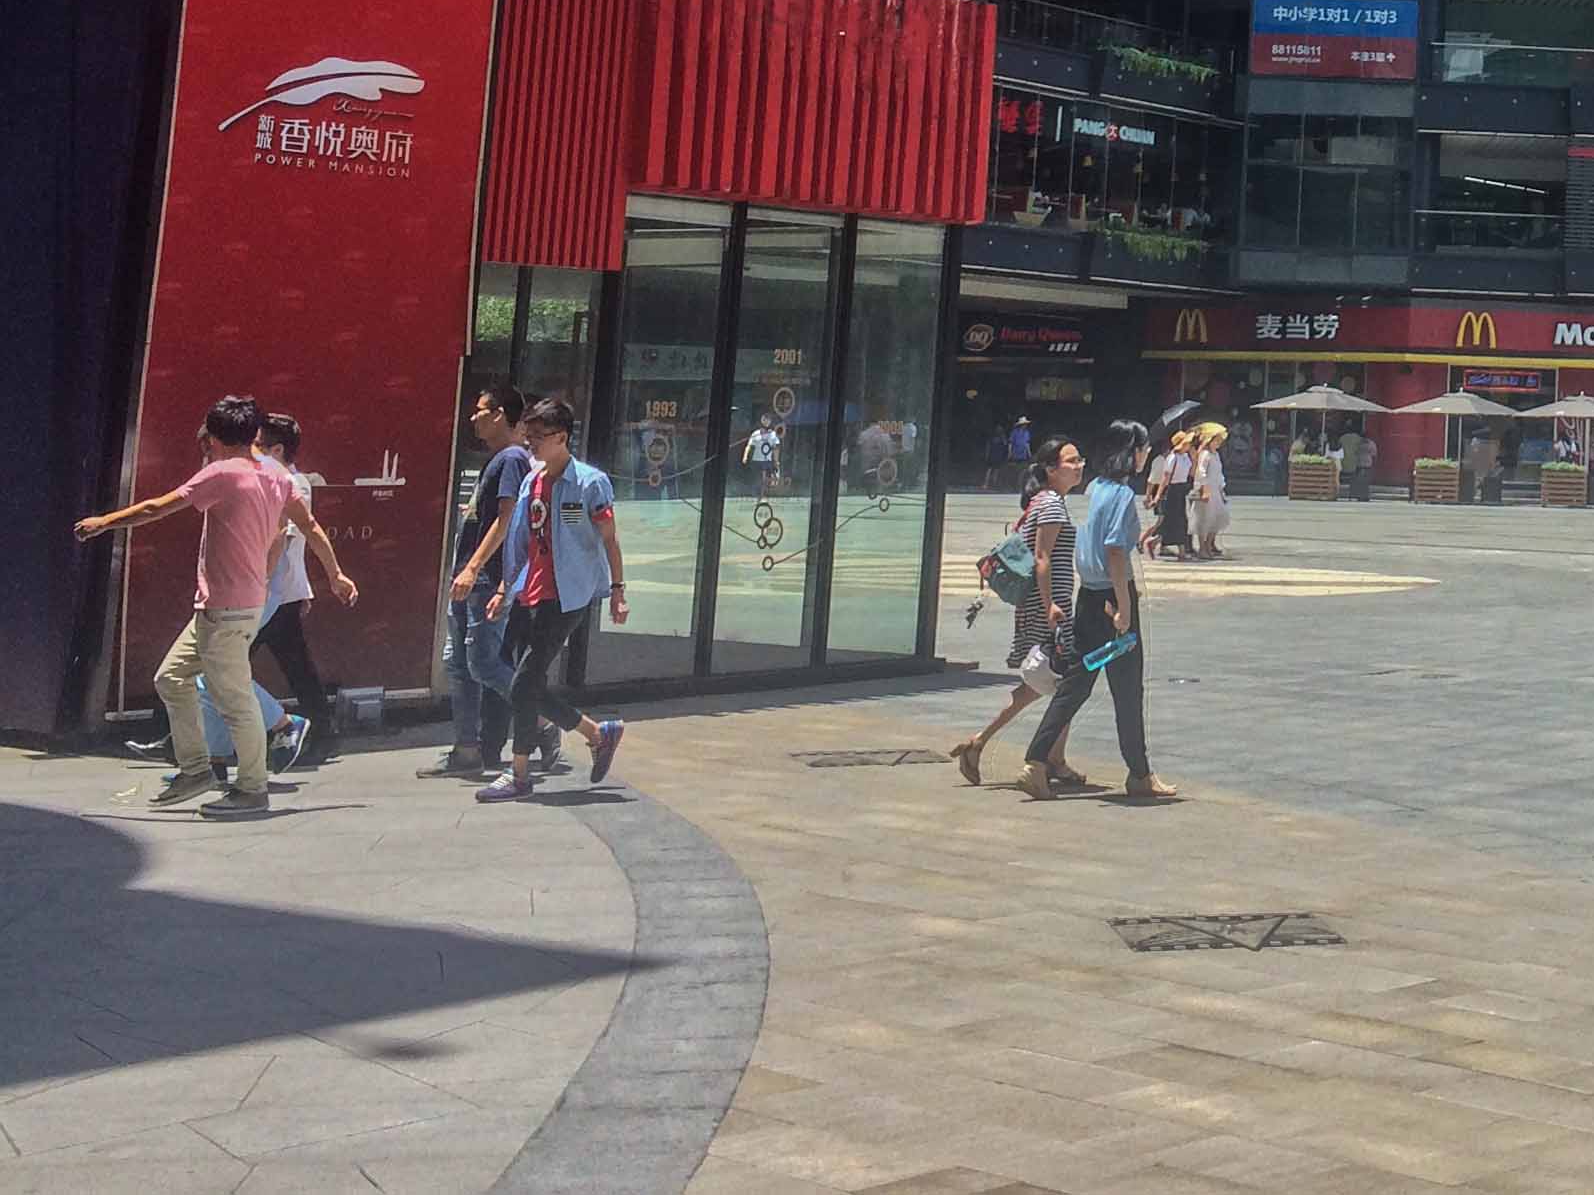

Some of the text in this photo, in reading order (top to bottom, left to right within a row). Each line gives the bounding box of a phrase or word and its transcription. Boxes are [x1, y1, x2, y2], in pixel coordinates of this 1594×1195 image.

[279, 118, 415, 165] 香悦奥府
[254, 152, 411, 179] POWER MANSION
[1254, 313, 1341, 341] 麦当劳
[645, 399, 678, 418] 1993
